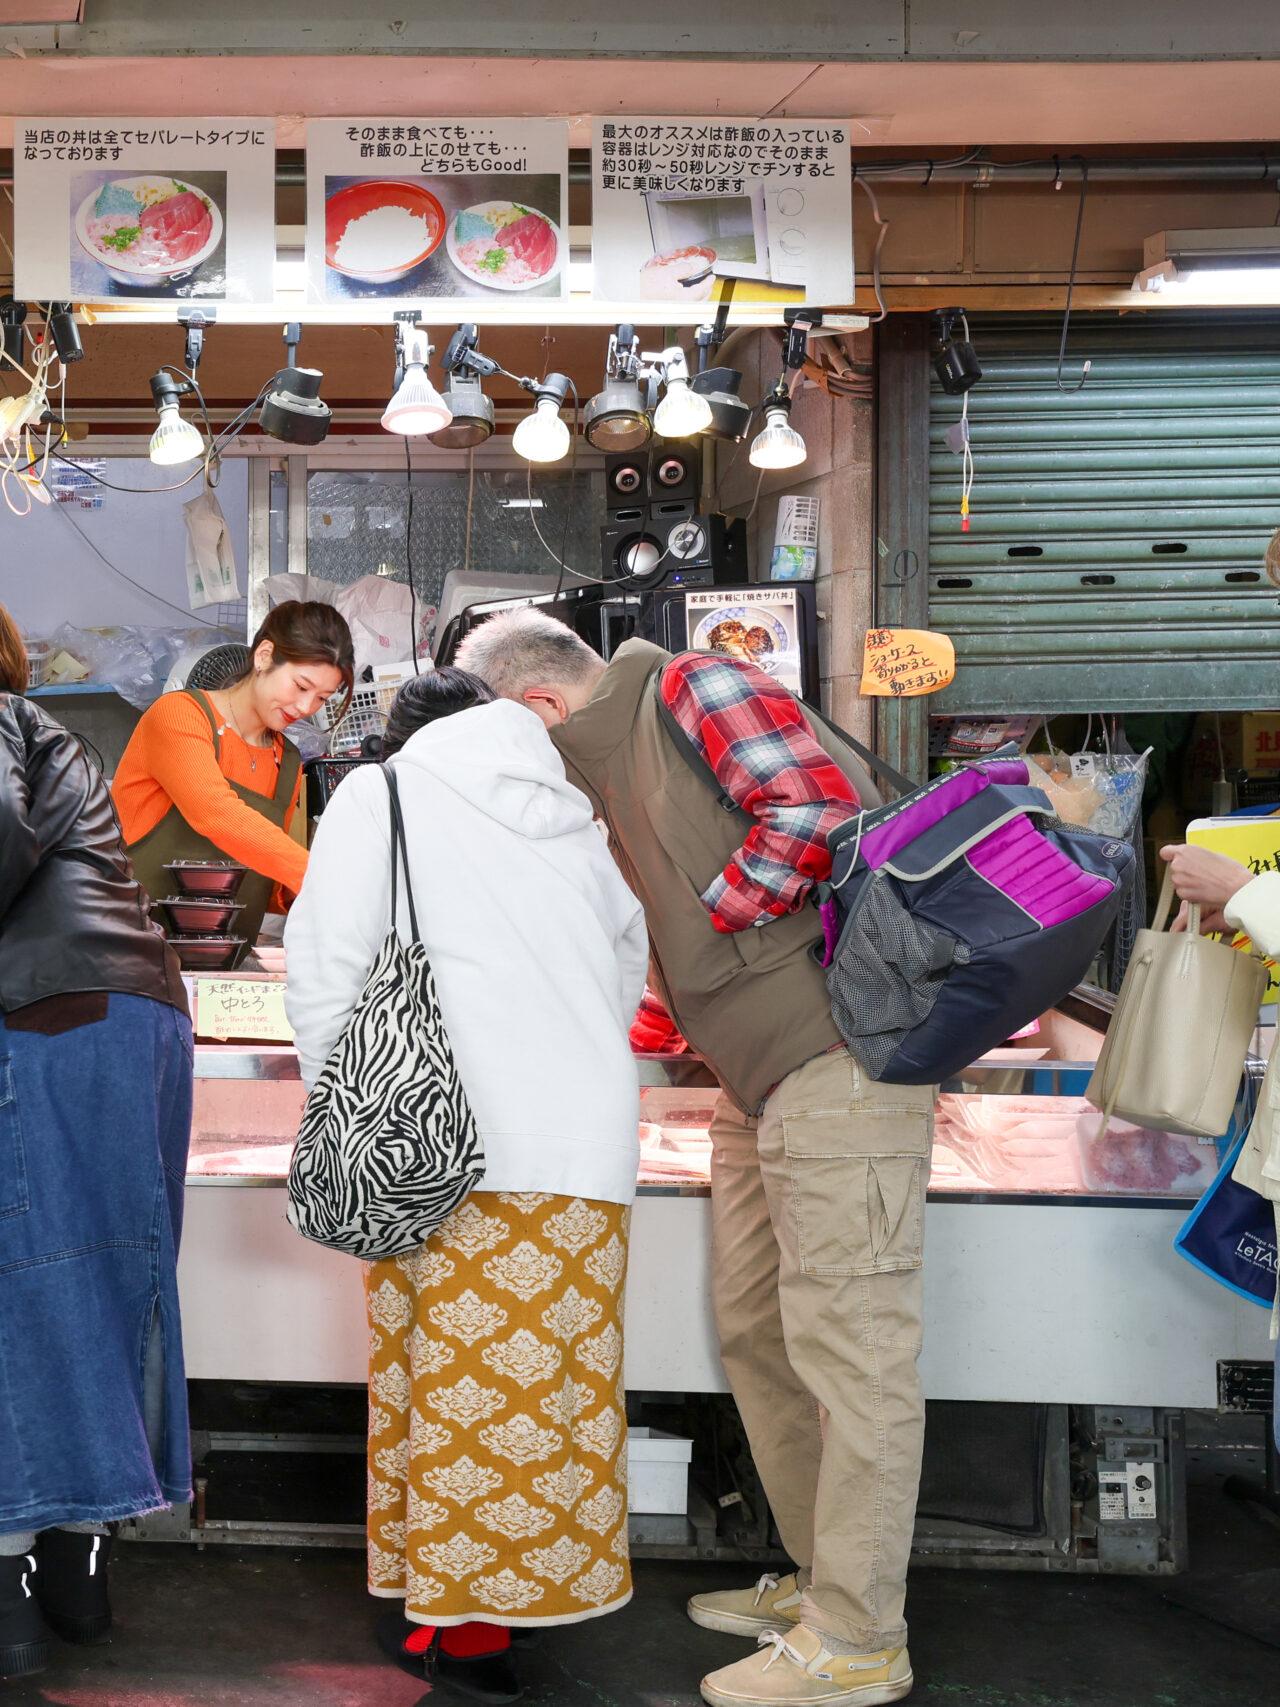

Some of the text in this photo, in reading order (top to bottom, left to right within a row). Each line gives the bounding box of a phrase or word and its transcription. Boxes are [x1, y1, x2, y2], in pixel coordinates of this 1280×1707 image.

[602, 124, 845, 144] 最大のオススメは酢飯の入っている
[24, 146, 124, 161] なっております
[602, 141, 829, 160] 容器はレンジ対応なのでそのまま
[420, 158, 527, 173] どちらもGood!
[602, 175, 745, 193] 更に美味しくなります
[221, 996, 265, 1013] 中とろ
